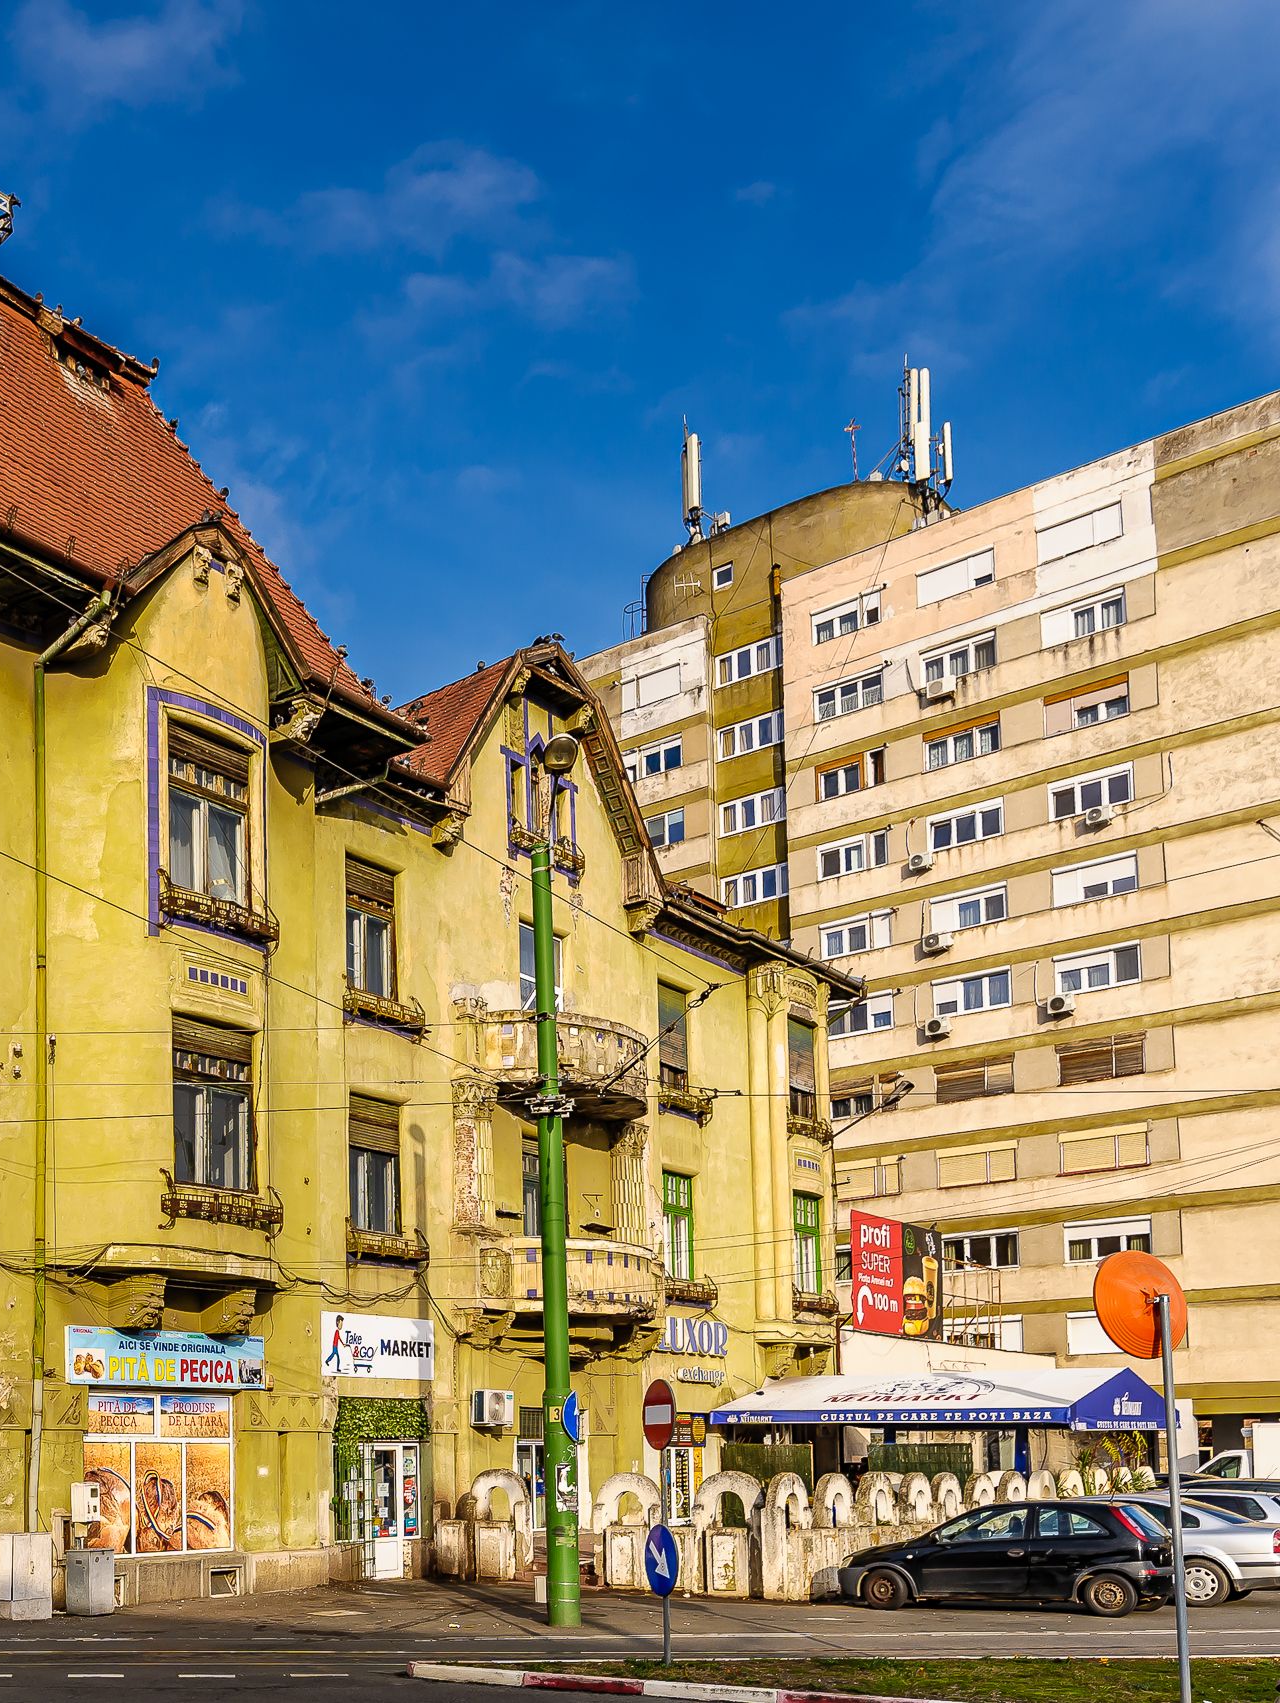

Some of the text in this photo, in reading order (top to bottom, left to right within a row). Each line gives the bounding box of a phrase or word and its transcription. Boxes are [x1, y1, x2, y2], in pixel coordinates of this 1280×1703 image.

[860, 1224, 890, 1248] profi
[861, 1251, 890, 1273] SUPER
[873, 1293, 898, 1312] 100 m
[345, 1330, 362, 1345] Take
[118, 1341, 226, 1354] AICI SE VINDE ORIGINALA
[353, 1346, 374, 1358] &GO
[380, 1339, 431, 1358] MARKET
[108, 1353, 234, 1383] PITĂ DE PECICA
[682, 1367, 724, 1385] exchange
[123, 1402, 136, 1412] DE
[173, 1401, 216, 1413] PRODUSE
[554, 1408, 560, 1420] 3
[820, 1411, 1052, 1422] GUSTUL PE CARE TE POȚI BAZA
[100, 1415, 137, 1427] PECICA
[168, 1416, 181, 1426] DE
[184, 1416, 195, 1426] LA
